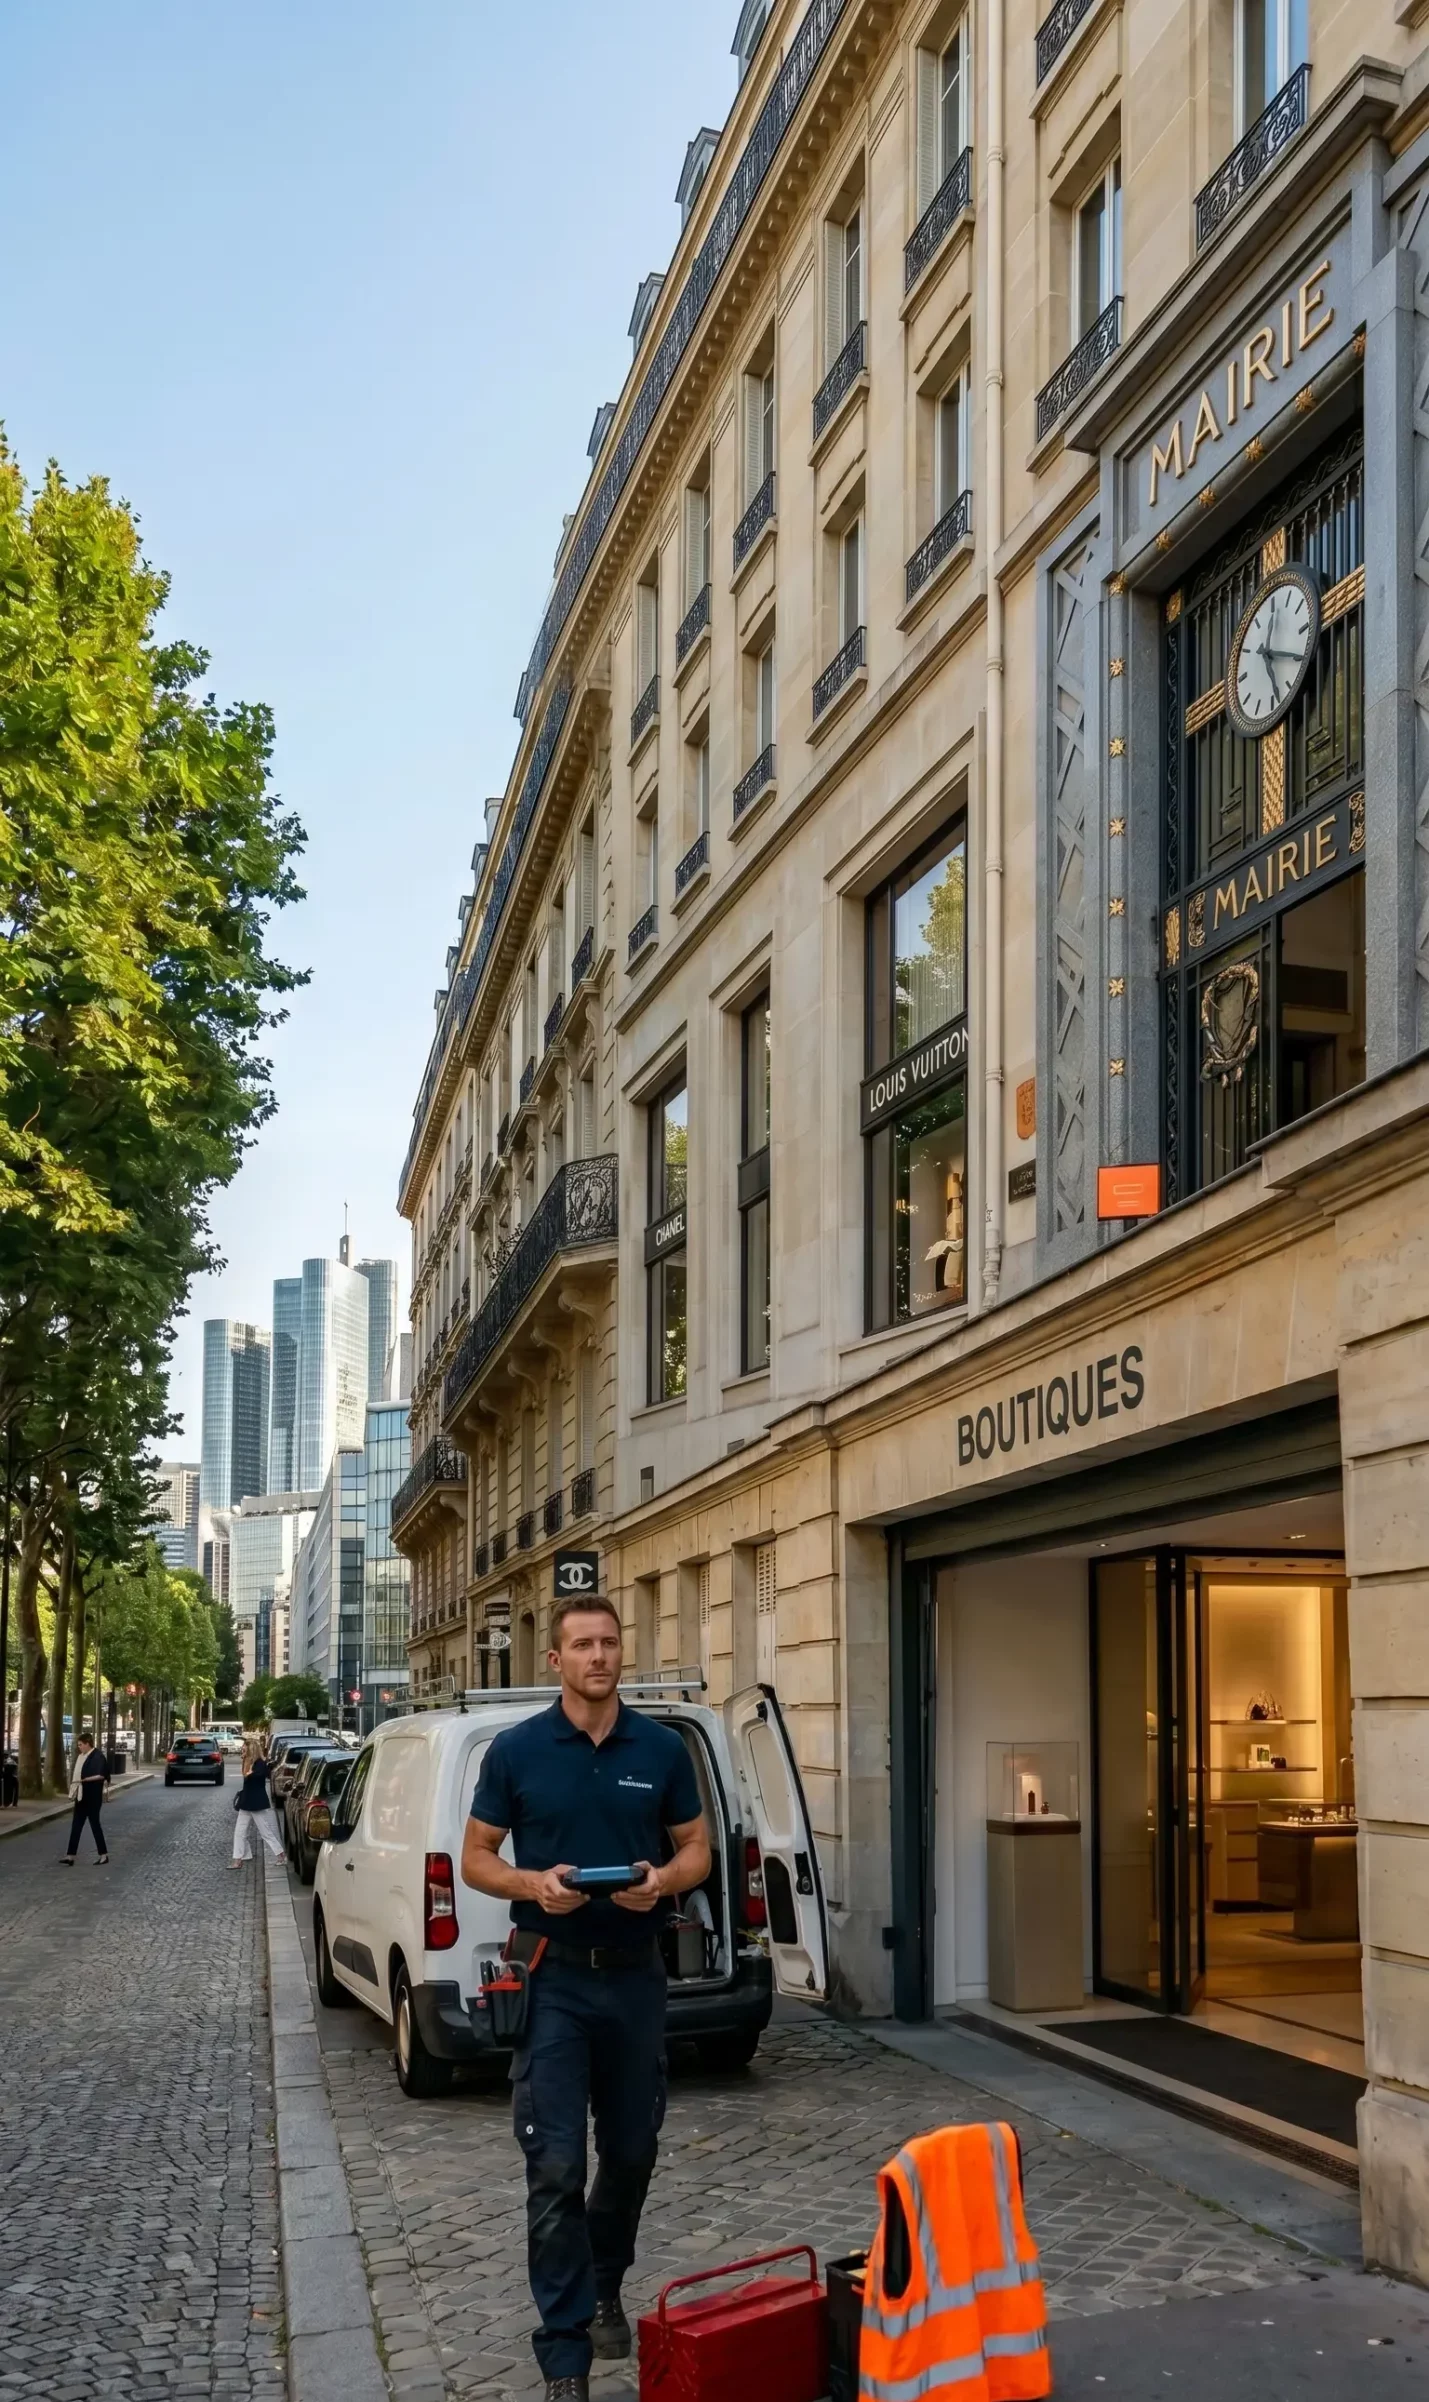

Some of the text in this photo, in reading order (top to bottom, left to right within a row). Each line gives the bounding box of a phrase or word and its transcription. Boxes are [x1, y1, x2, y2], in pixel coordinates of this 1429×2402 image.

[1149, 260, 1334, 507] MAIRIE
[1213, 814, 1337, 931] MAIRIE
[870, 1067, 906, 1113] LOUIS
[958, 1345, 1145, 1467] BOUTIQUES
